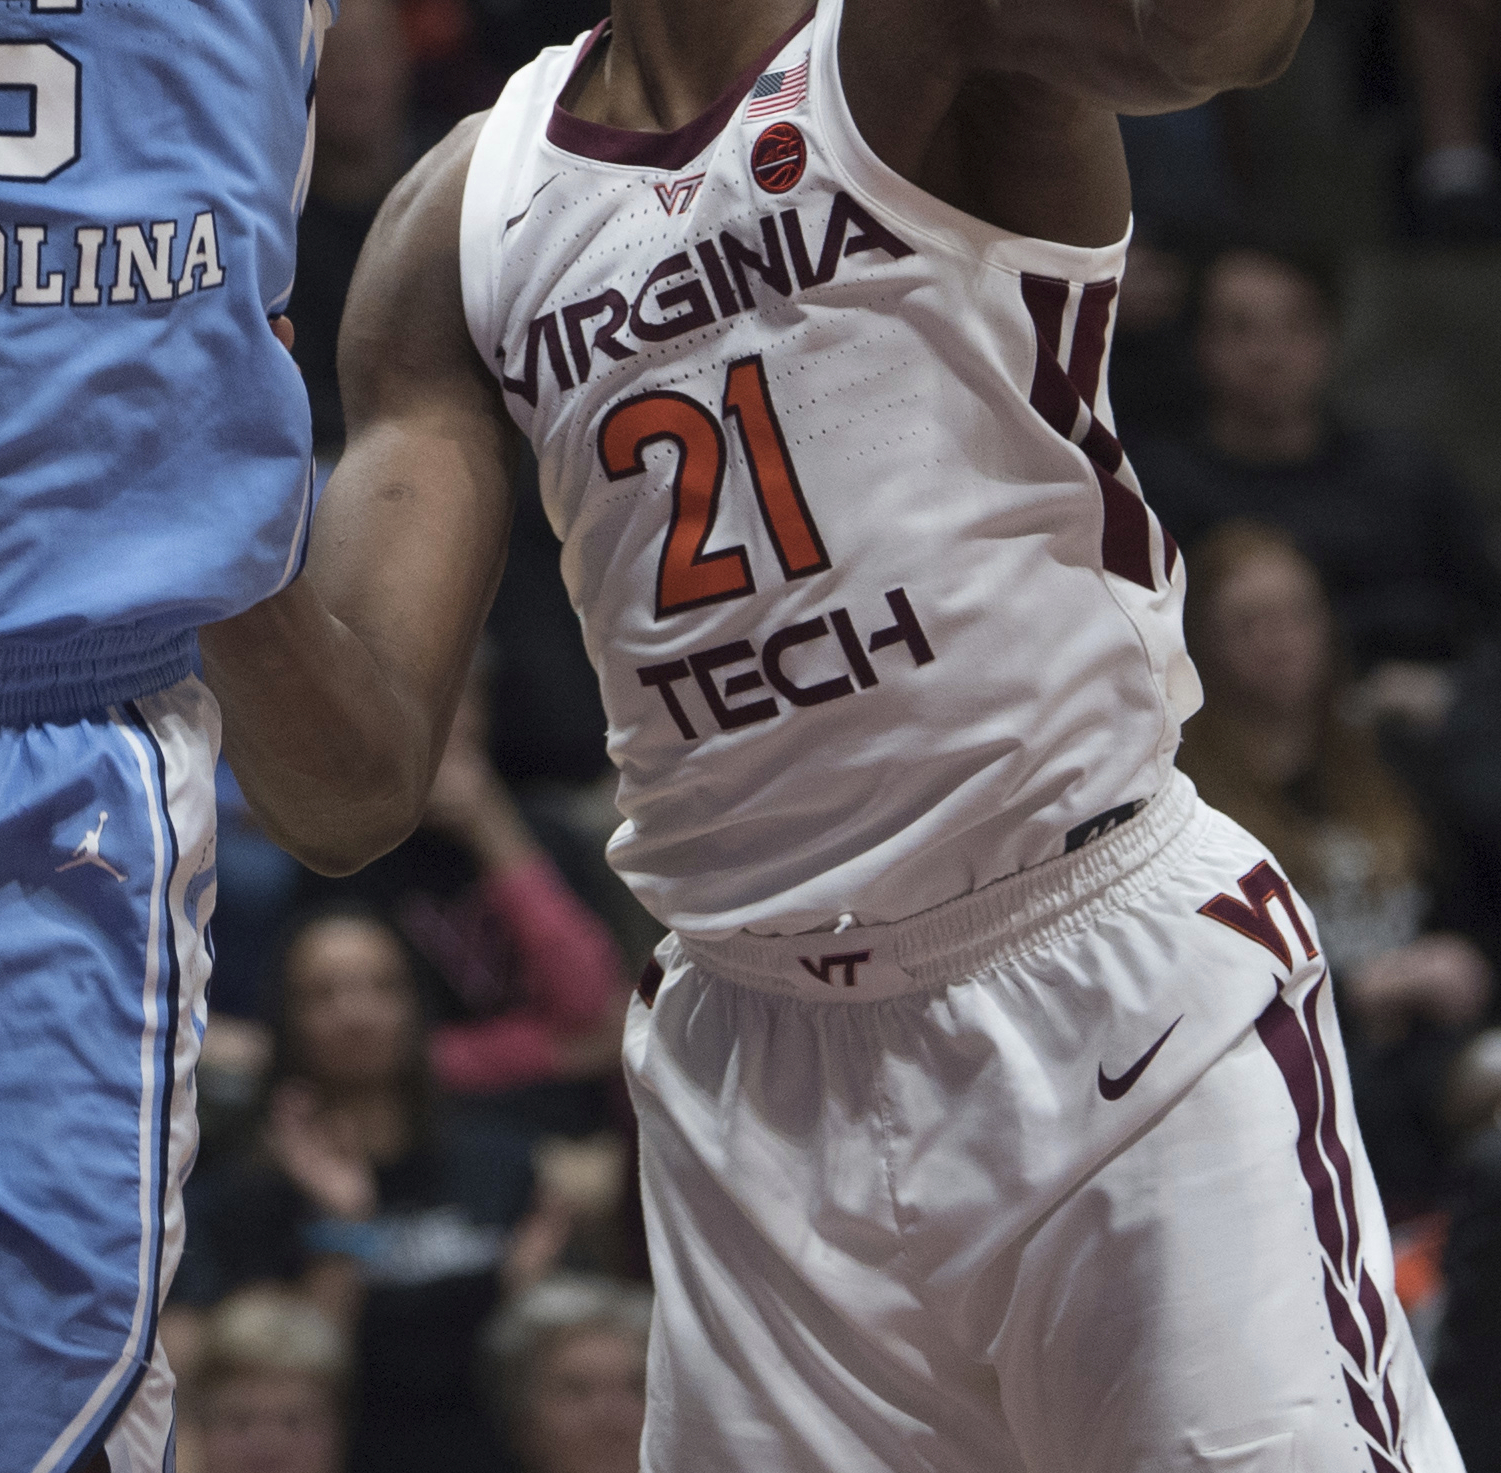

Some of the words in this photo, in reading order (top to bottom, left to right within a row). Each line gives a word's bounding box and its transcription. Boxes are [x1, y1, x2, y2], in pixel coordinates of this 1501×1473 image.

[503, 191, 917, 408] VIRGINIA
[598, 353, 832, 622] 21
[636, 587, 935, 742] TECH
